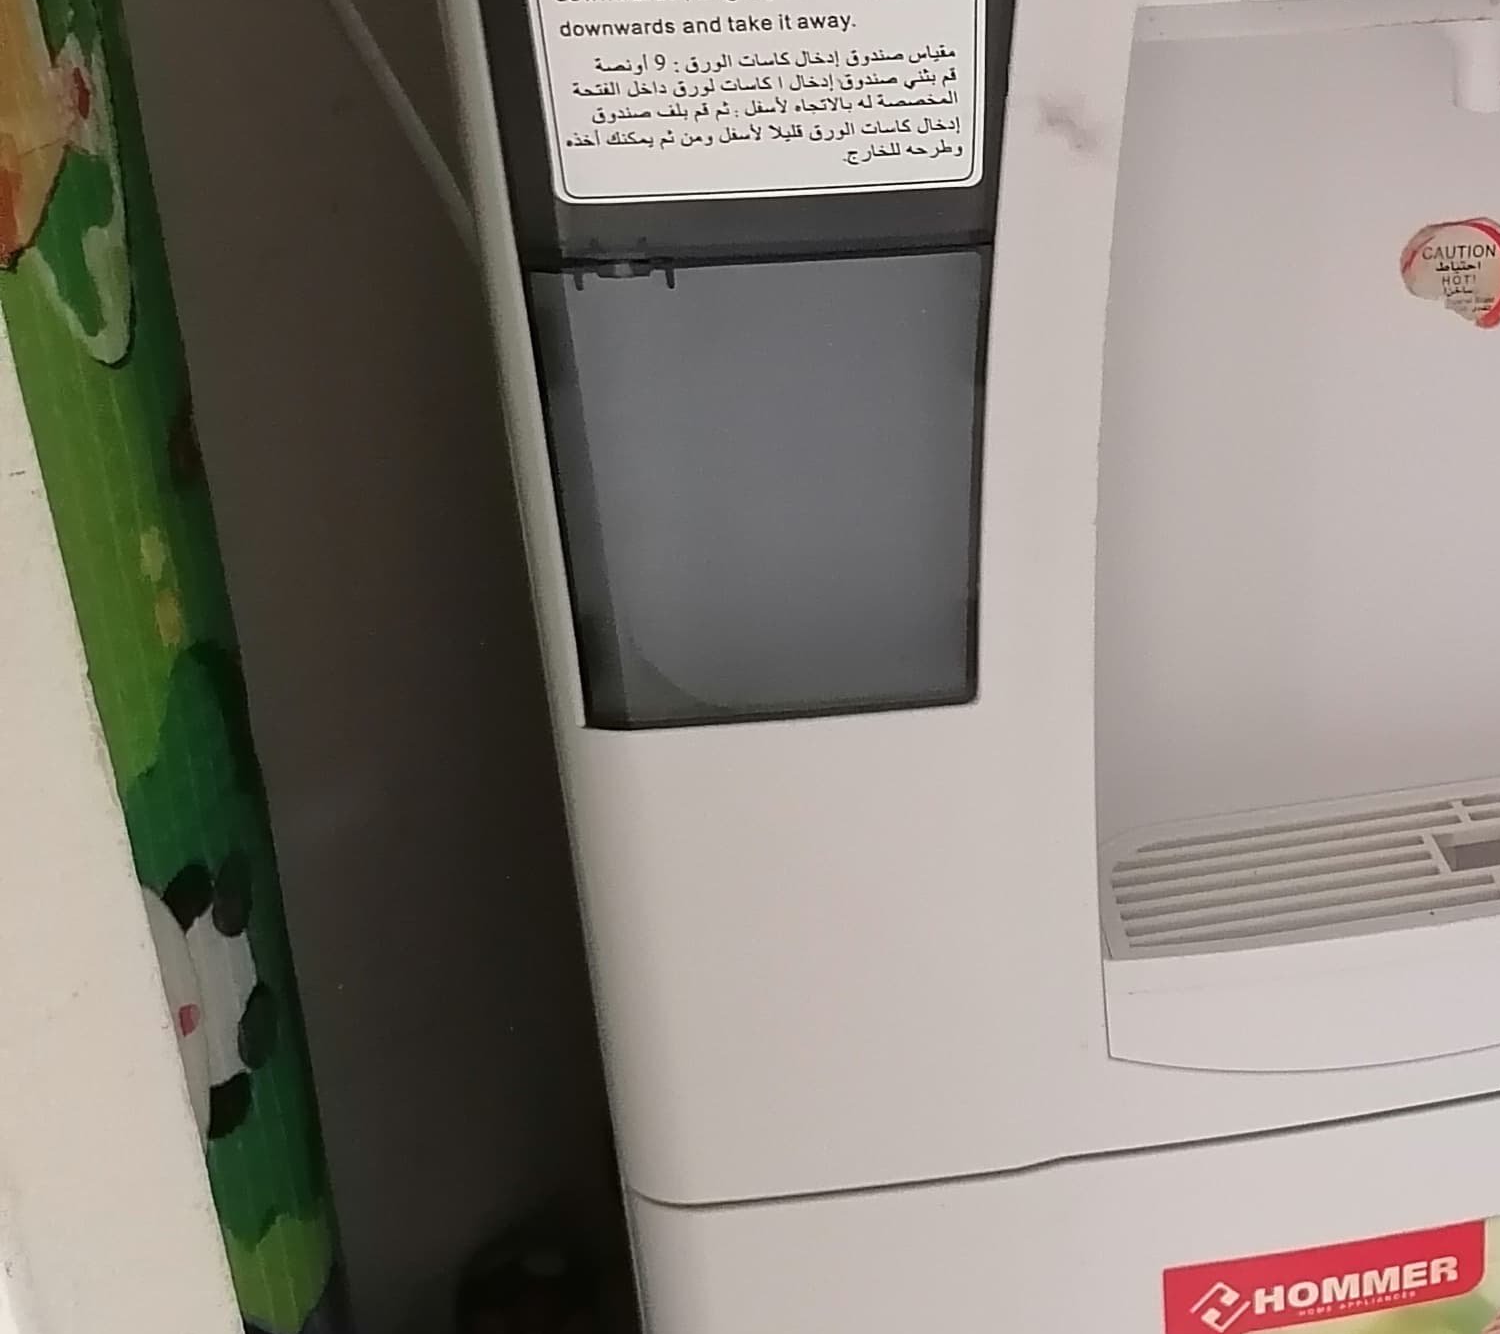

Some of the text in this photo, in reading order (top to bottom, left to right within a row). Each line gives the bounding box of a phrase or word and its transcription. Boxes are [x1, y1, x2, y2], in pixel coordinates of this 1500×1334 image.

[559, 13, 857, 38] downwards and take it away.
[684, 53, 733, 74] الورق
[737, 51, 791, 68] كاسات
[845, 49, 905, 67] صندوق
[908, 44, 956, 64] مقياس
[719, 75, 773, 92] كاسات
[836, 72, 899, 91] صندوق
[941, 66, 957, 88] قم
[572, 81, 621, 97] الفتحة
[626, 80, 668, 98] داخل
[672, 77, 716, 98] لورق
[794, 96, 853, 115] بالاتجاه
[857, 93, 873, 109] له
[876, 89, 959, 108] المخصصة
[591, 106, 652, 125] صندوق
[656, 102, 689, 121] بلف
[693, 102, 710, 124] قم
[715, 100, 731, 122] ثم
[767, 123, 804, 143] قليلا
[808, 121, 856, 142] الورق
[860, 118, 912, 135] كاسات
[605, 130, 655, 149] يمكنك
[680, 132, 714, 148] ومن
[905, 138, 963, 159] وطرحه
[1421, 244, 1497, 261] CAUTION
[1254, 1256, 1458, 1315] HOMMER
